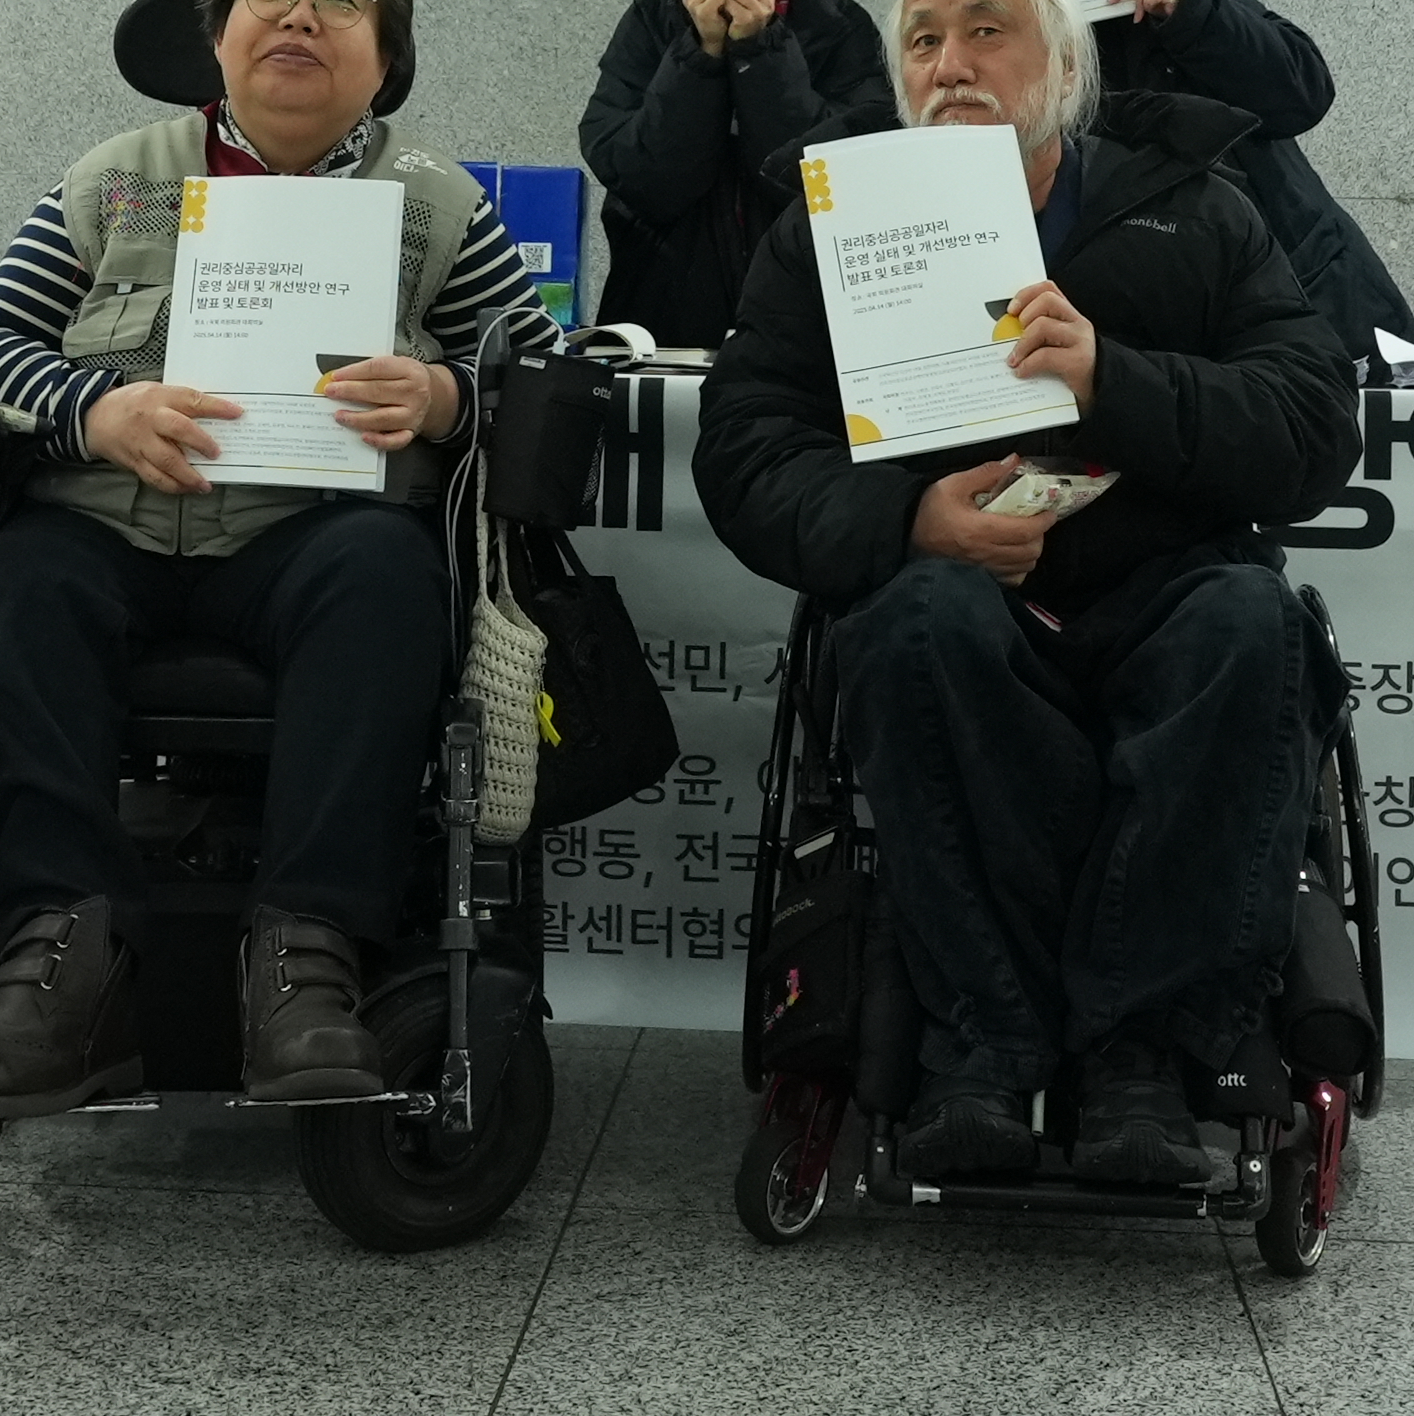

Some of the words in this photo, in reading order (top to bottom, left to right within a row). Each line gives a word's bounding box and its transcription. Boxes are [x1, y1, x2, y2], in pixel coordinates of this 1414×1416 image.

[840, 219, 949, 252] 권리중심공공일자리
[844, 251, 870, 269] 운영
[873, 246, 900, 264] 실태
[903, 242, 916, 258] 및
[919, 233, 972, 254] 개선방안
[974, 231, 1000, 246] 연구
[199, 262, 304, 276] 권리중심공공일자리
[847, 269, 873, 286] 발표
[875, 266, 888, 281] 및
[890, 258, 928, 278] 토론회
[198, 279, 223, 294] 운영
[225, 279, 250, 294] 실태
[253, 279, 266, 294] 및
[268, 280, 322, 295] 개선방안
[324, 282, 351, 296] 연구
[196, 296, 220, 310] 발표
[222, 296, 235, 310] 및
[236, 296, 274, 310] 토론회
[643, 640, 743, 702] 선민,
